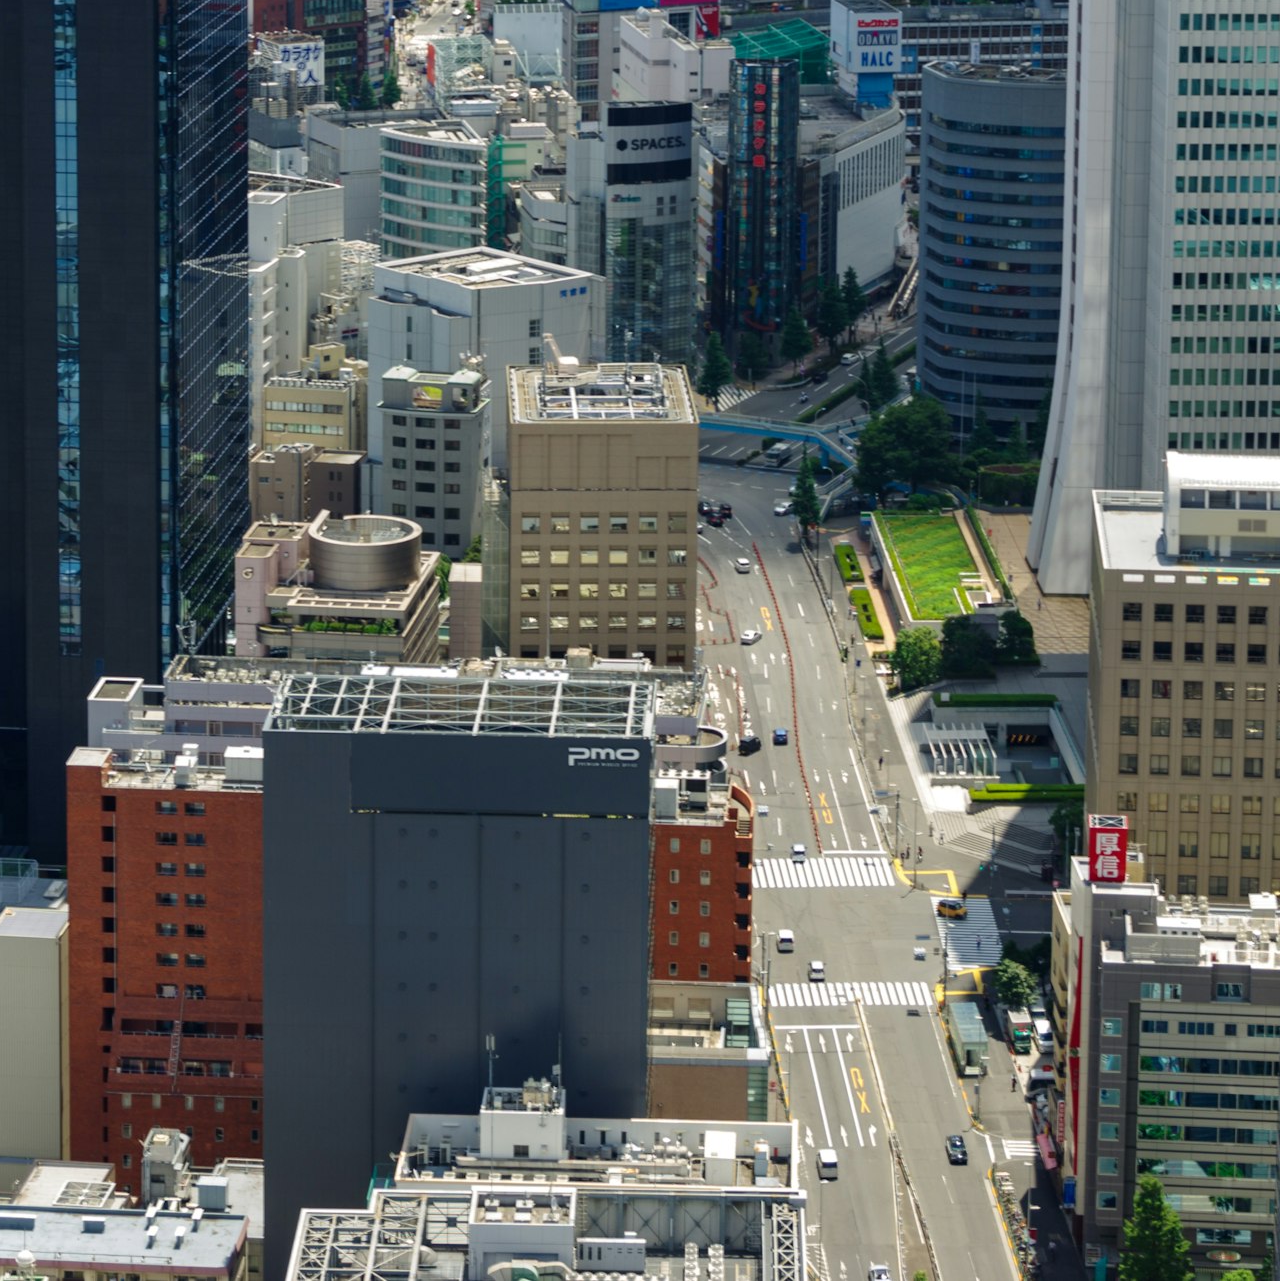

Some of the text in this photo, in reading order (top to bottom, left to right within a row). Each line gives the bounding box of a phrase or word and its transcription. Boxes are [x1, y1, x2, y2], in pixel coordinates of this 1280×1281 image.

[858, 33, 898, 46] ODAKYU
[281, 45, 322, 63] カラオケ
[861, 50, 894, 67] HALC
